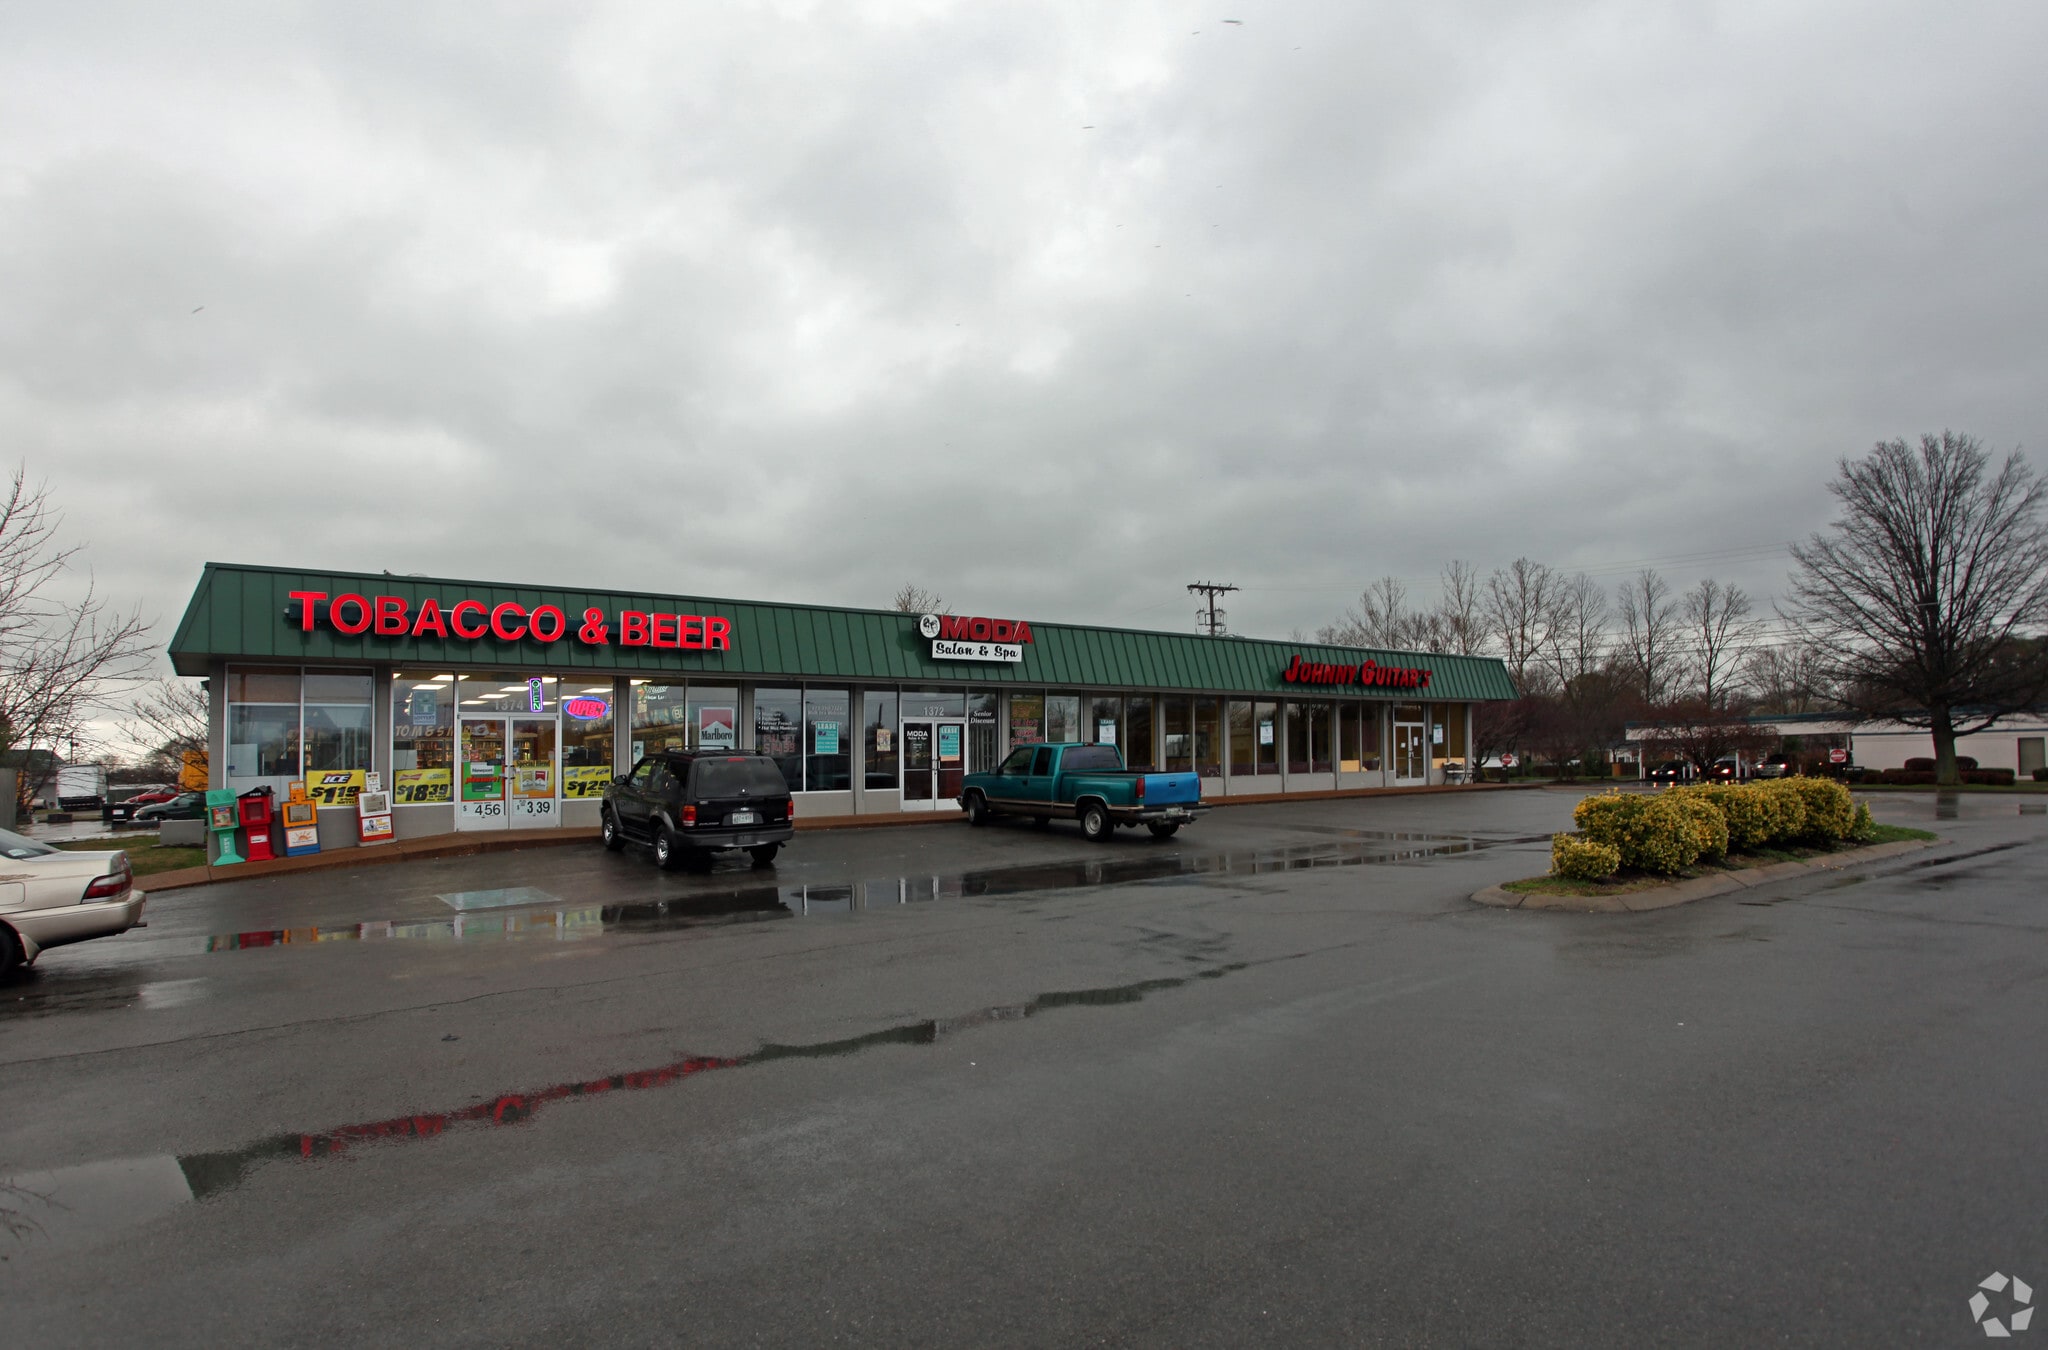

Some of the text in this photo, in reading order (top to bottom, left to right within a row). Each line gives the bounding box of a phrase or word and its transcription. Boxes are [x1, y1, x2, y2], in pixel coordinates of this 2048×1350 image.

[289, 591, 731, 651] TOBACCO & BEER
[940, 615, 1034, 644] MODA
[935, 642, 1018, 660] Salon & Spa
[1285, 655, 1433, 688] JOHNNY GUITAR'S
[495, 700, 524, 710] 1374
[567, 699, 606, 718] OPEN
[923, 706, 944, 716] 1372
[701, 728, 733, 740] Marlboro
[323, 775, 350, 784] ICE
